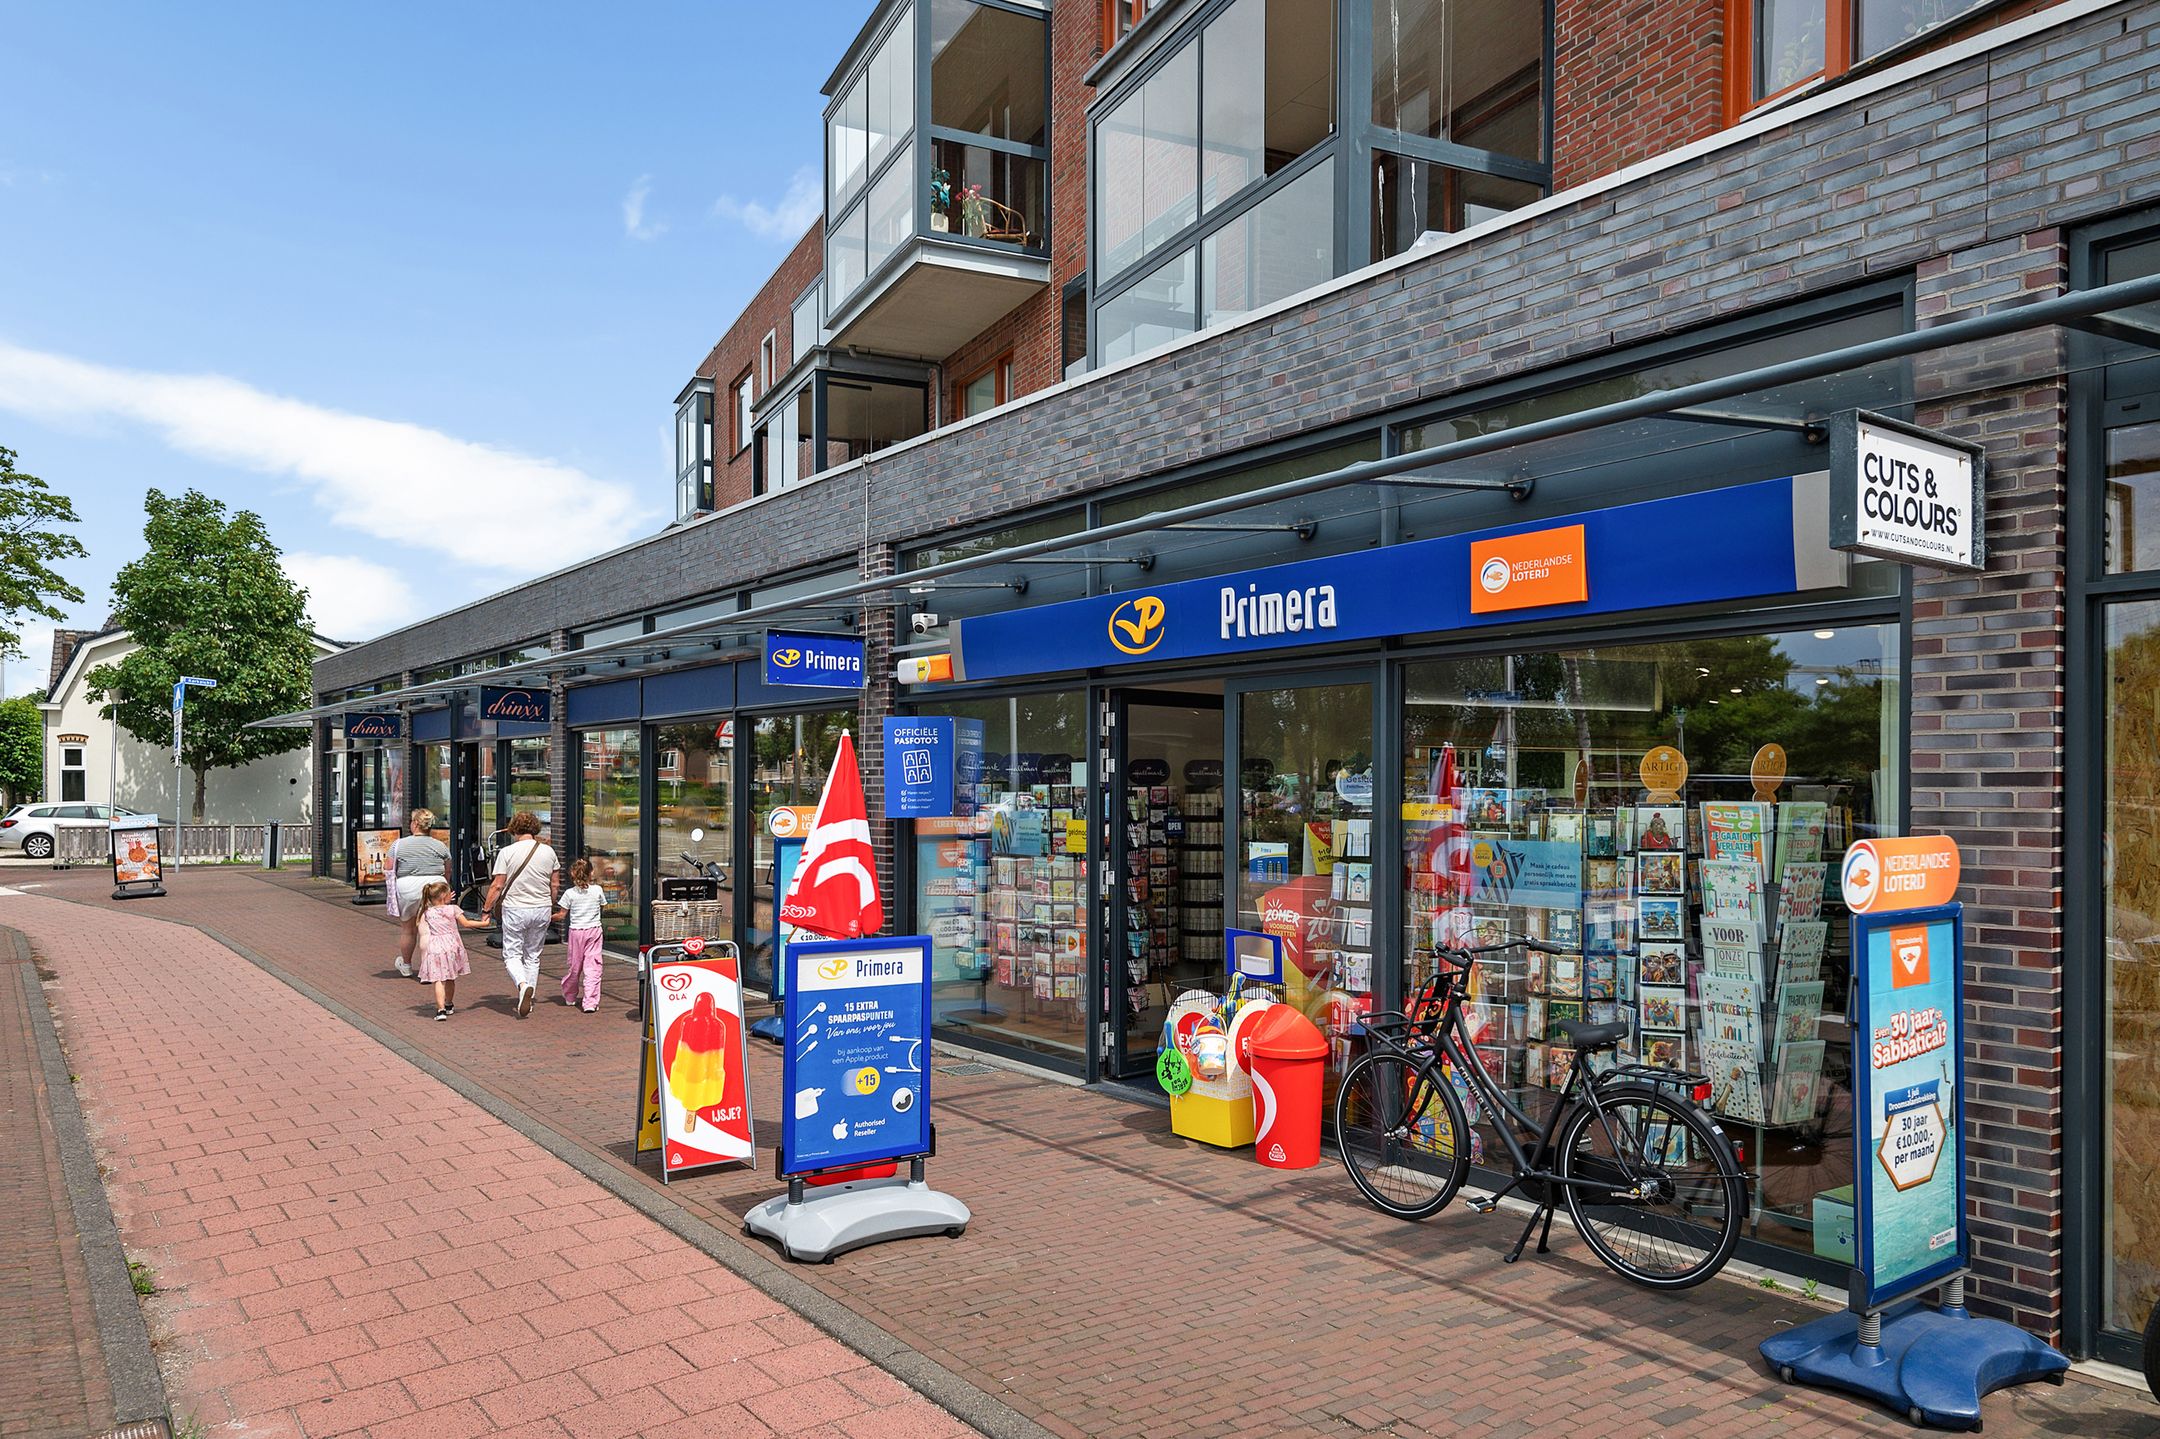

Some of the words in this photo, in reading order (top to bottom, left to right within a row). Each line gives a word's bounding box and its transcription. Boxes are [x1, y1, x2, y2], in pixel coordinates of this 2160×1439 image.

[1864, 452, 1919, 494] CUTS
[1924, 468, 1938, 498] &
[1864, 487, 1957, 536] COLOURS
[1871, 528, 1954, 554] WWW.CUTSANDCOLOURS.NL
[1512, 554, 1572, 572] NEDERLANDSE
[1512, 568, 1549, 582] LOTERIJ
[1220, 583, 1337, 639] Primera
[805, 650, 860, 672] Primera
[487, 690, 544, 719] drinxx
[350, 716, 395, 737] drinxx
[893, 727, 938, 737] OFFICIËLE
[894, 737, 939, 745] PASFOTO'S
[1168, 821, 1182, 831] OPEN
[1720, 831, 1740, 841] GAAT
[1884, 852, 1952, 873] NEDERLANDSE
[1884, 872, 1926, 893] LOTERIJ
[1796, 883, 1814, 899] BIG
[1791, 900, 1813, 917] HUG
[1265, 909, 1300, 928] ZOMER
[1712, 927, 1744, 942] VOOR
[1720, 950, 1741, 962] ONZE
[856, 959, 903, 978] Primera
[669, 993, 688, 1001] OLA
[1807, 993, 1820, 1005] YOU
[844, 1003, 854, 1012] 15
[856, 1000, 879, 1011] EXTRA
[828, 1010, 894, 1024] SPAARPASPUNTEN
[1874, 1027, 1890, 1040] Even
[1890, 1012, 1909, 1041] 30
[1909, 1007, 1935, 1037] jaar
[825, 1026, 844, 1040] Van
[863, 1023, 882, 1033] voor
[877, 1021, 896, 1038] jou
[837, 1048, 846, 1057] bij
[846, 1046, 872, 1056] aankoop
[1872, 1020, 1948, 1069] Sabbatical?
[845, 1055, 865, 1065] Apple
[865, 1053, 889, 1062] product
[857, 1073, 876, 1087] +15
[1911, 1087, 1920, 1098] juli
[711, 1106, 742, 1123] IJSJE?
[854, 1118, 886, 1129] Authorised
[1902, 1116, 1912, 1131] 30
[1913, 1115, 1928, 1131] jaar
[854, 1129, 877, 1138] Reseller
[1896, 1129, 1933, 1150] €10.000,-
[1894, 1152, 1909, 1168] per
[1910, 1141, 1935, 1160] maand
